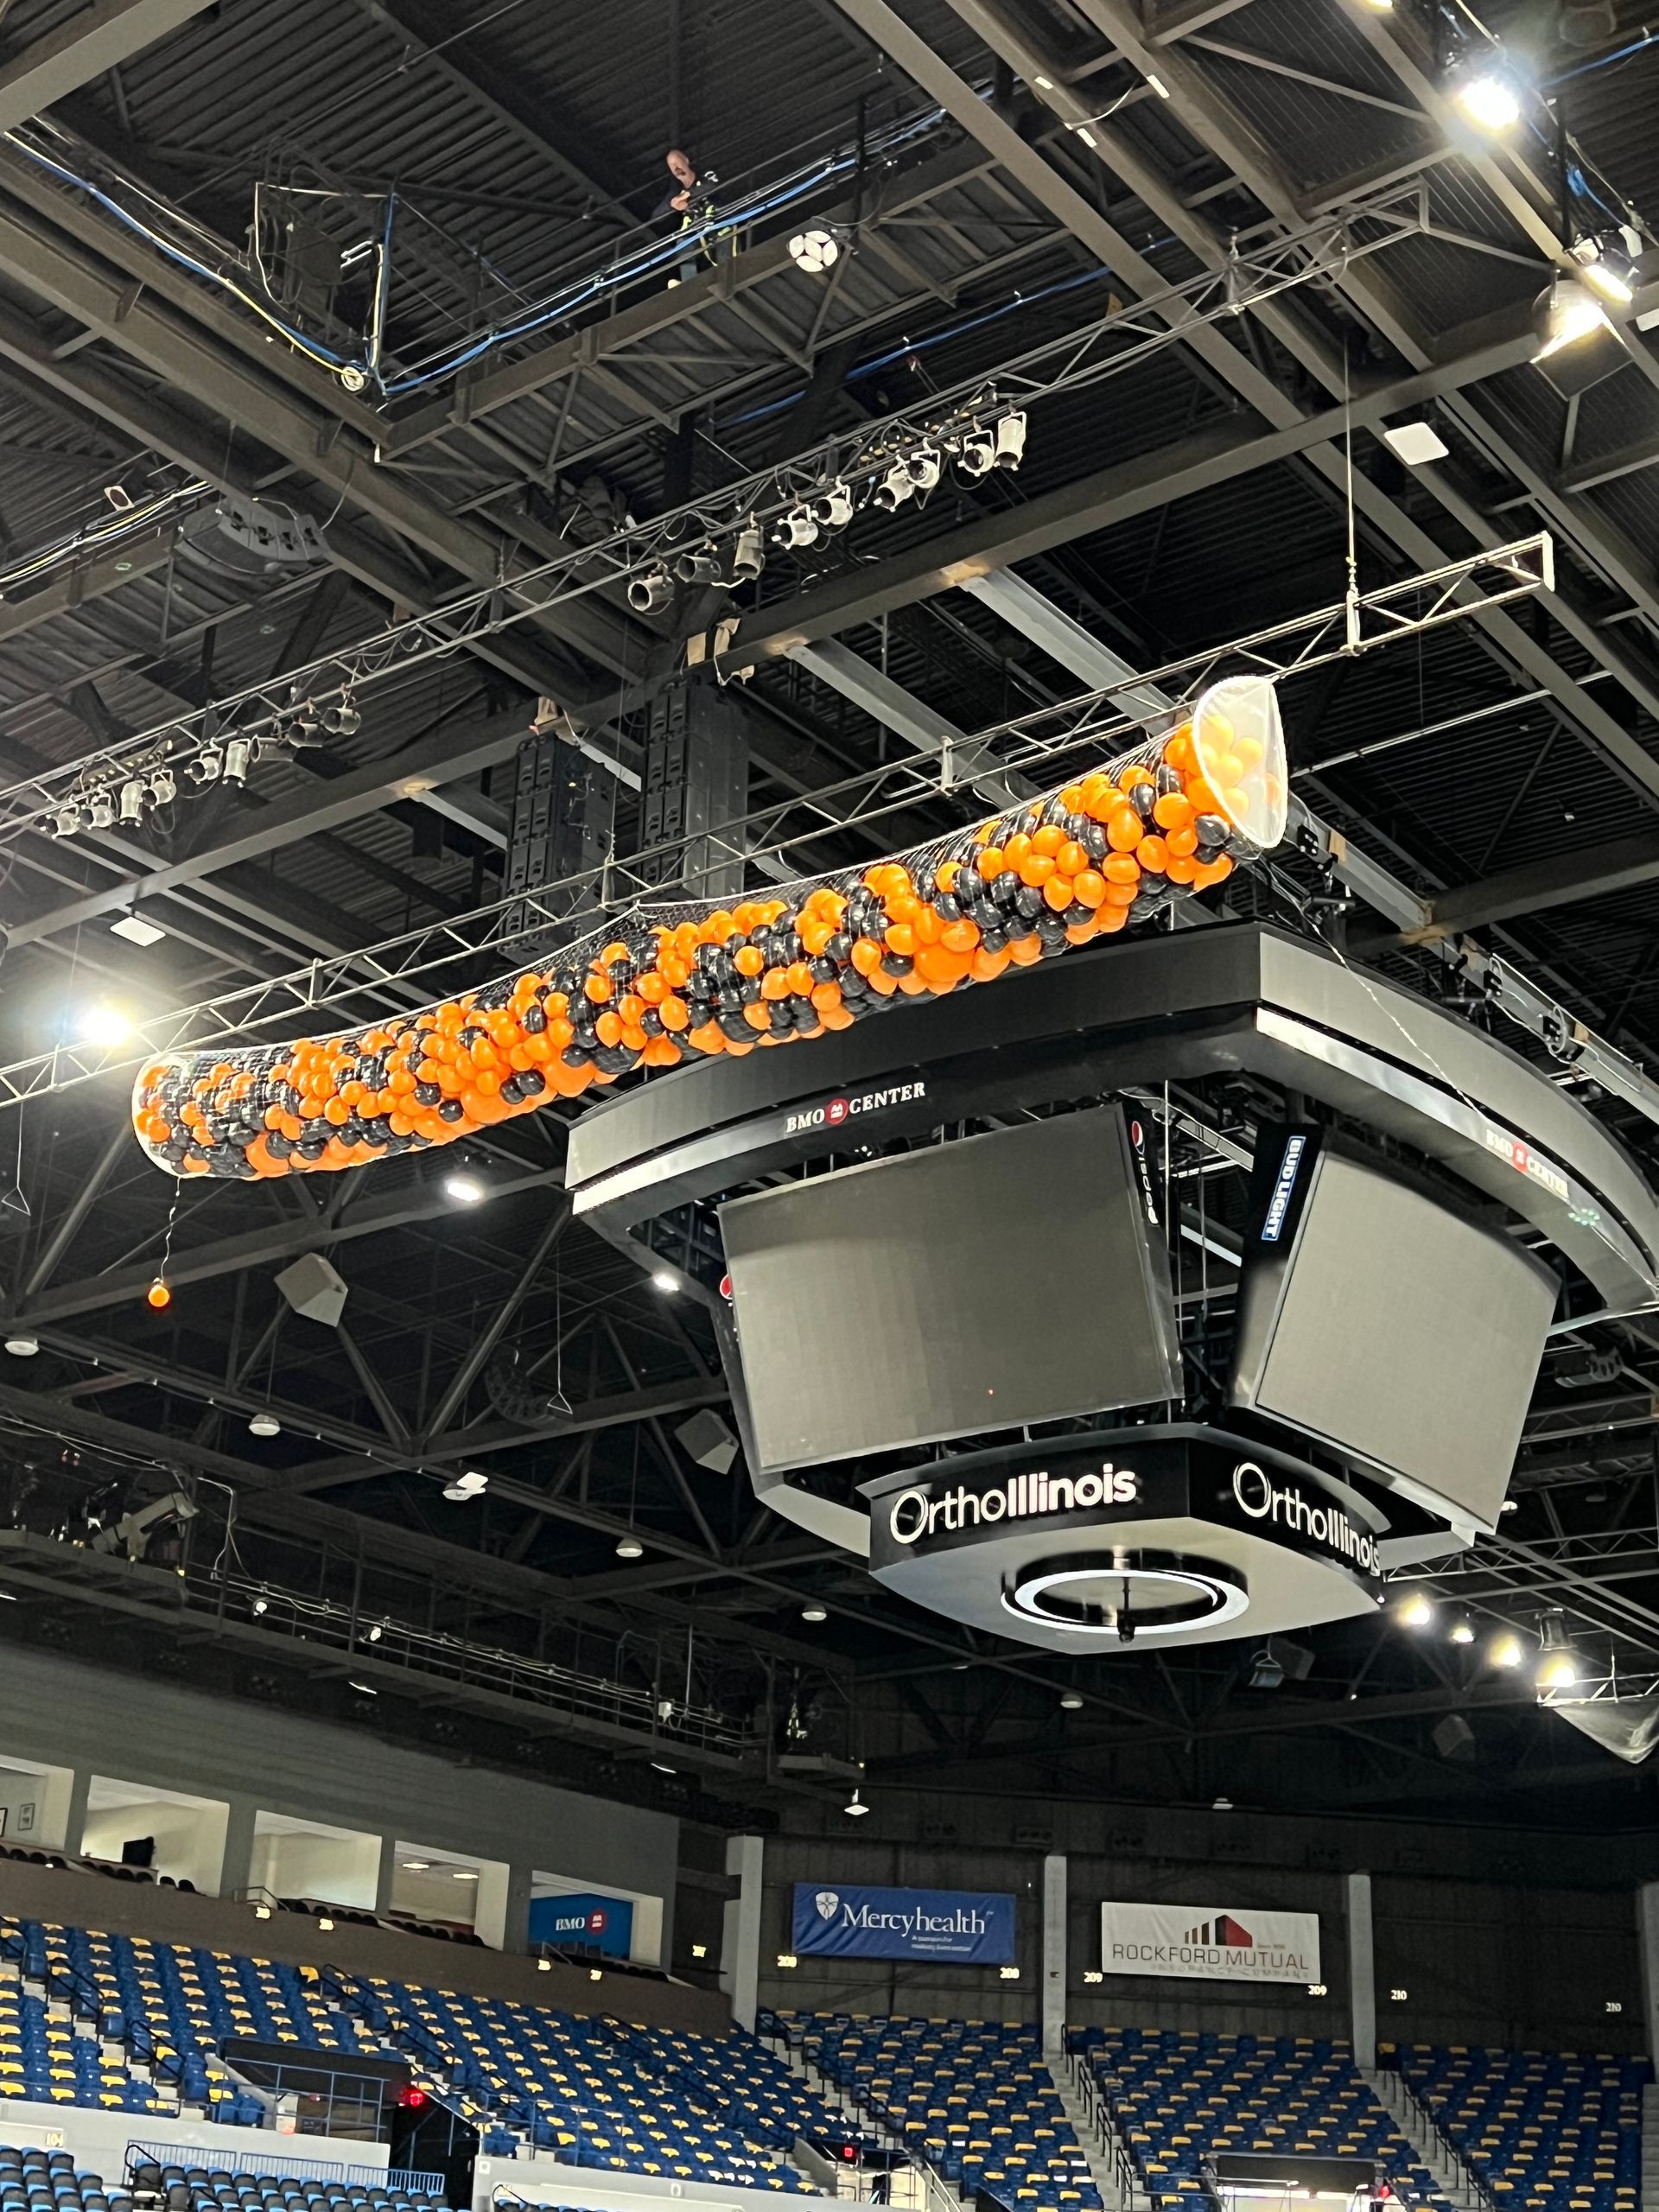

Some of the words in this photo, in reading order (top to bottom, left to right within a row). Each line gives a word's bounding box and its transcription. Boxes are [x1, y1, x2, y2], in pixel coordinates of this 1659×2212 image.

[786, 1108, 825, 1133] BMO
[849, 1082, 925, 1115] CENTER
[1281, 1140, 1302, 1180] BUD
[1138, 1157, 1159, 1224] pepsi
[1265, 1181, 1291, 1237] LIGHT
[890, 1463, 1137, 1544] OrthoIllinois
[1233, 1462, 1381, 1577] OrthoIllinois
[556, 1916, 585, 1931] BMO
[842, 1903, 985, 1937] Mercyhealth
[1112, 1944, 1221, 1964] ROCKFORD
[1225, 1949, 1310, 1970] MUTUAL
[1084, 1971, 1103, 1983] 209
[1307, 1984, 1327, 1996] 209
[1390, 1989, 1408, 2000] 210
